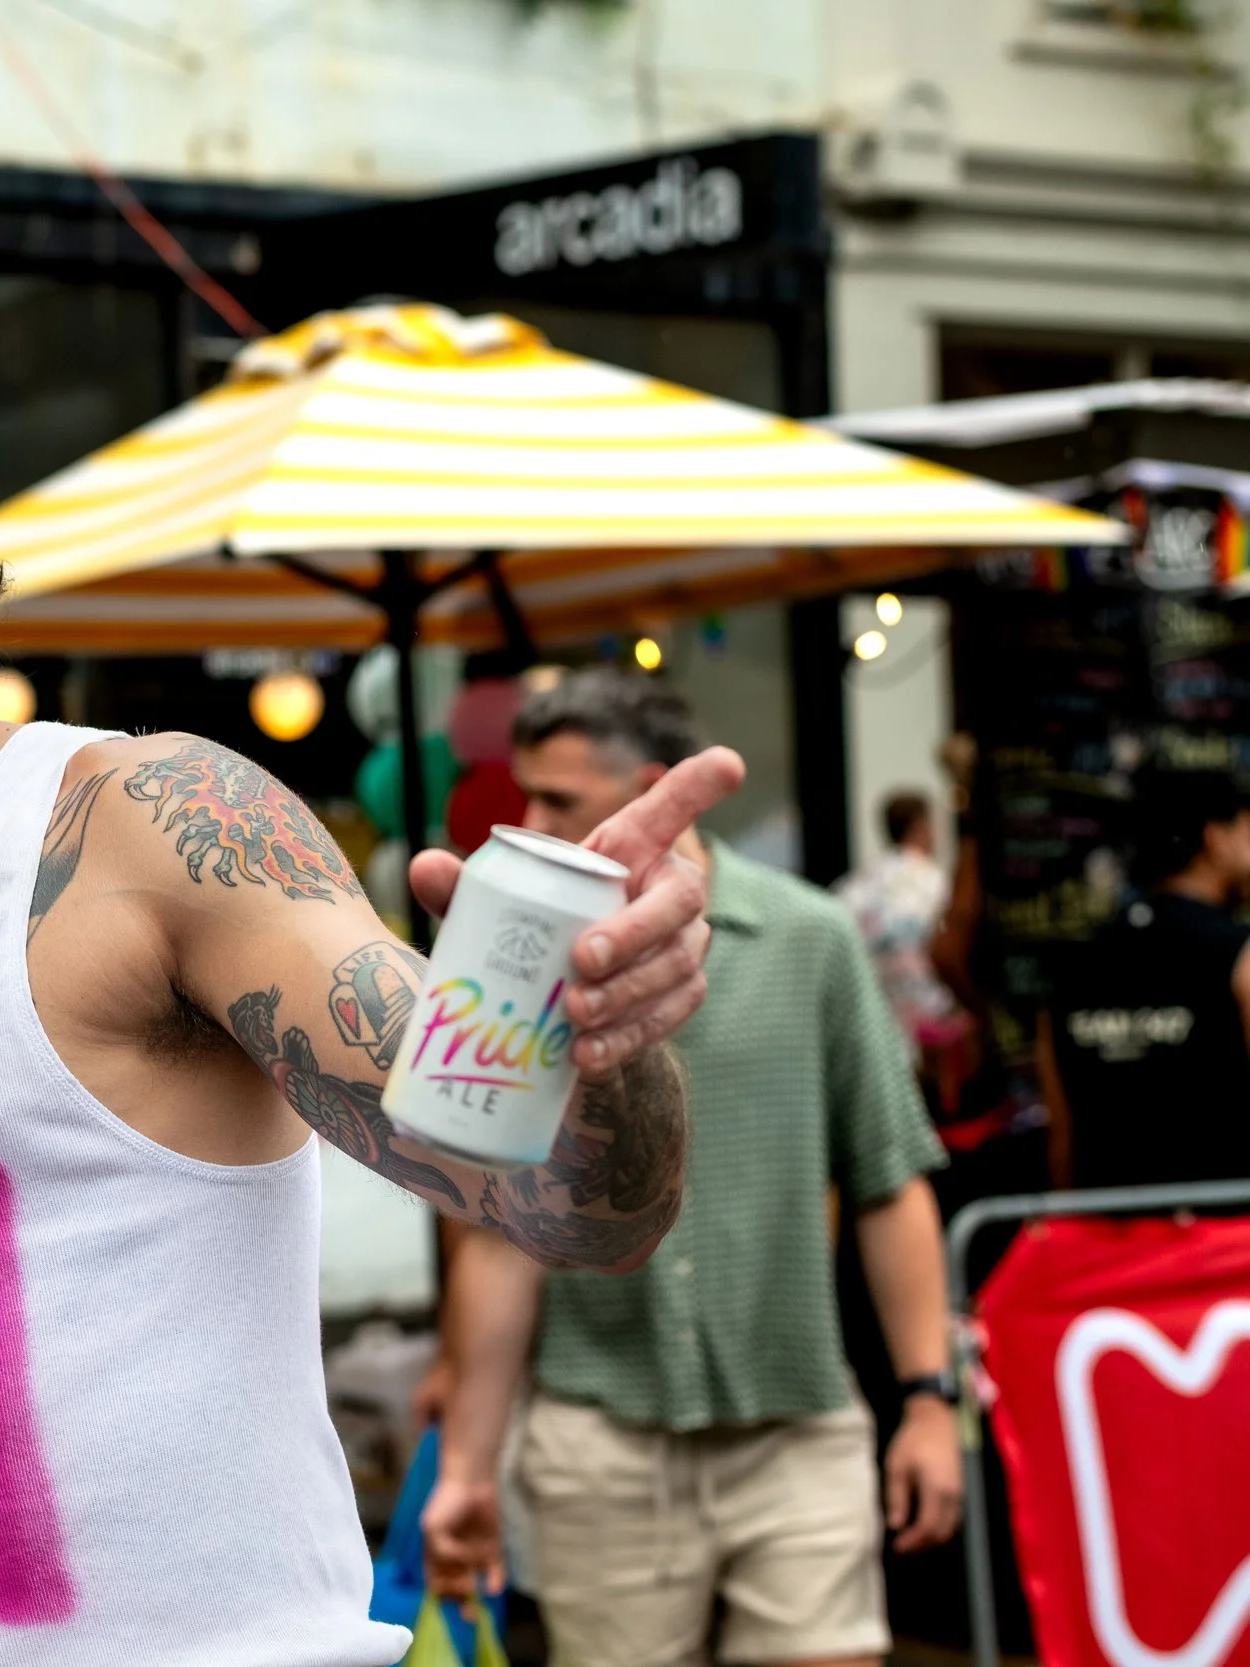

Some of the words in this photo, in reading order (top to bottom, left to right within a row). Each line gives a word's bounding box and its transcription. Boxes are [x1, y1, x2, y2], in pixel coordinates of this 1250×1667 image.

[496, 156, 740, 274] arcadia
[341, 950, 387, 973] LIFE
[411, 977, 572, 1075] Pride
[437, 1077, 502, 1115] ALE
